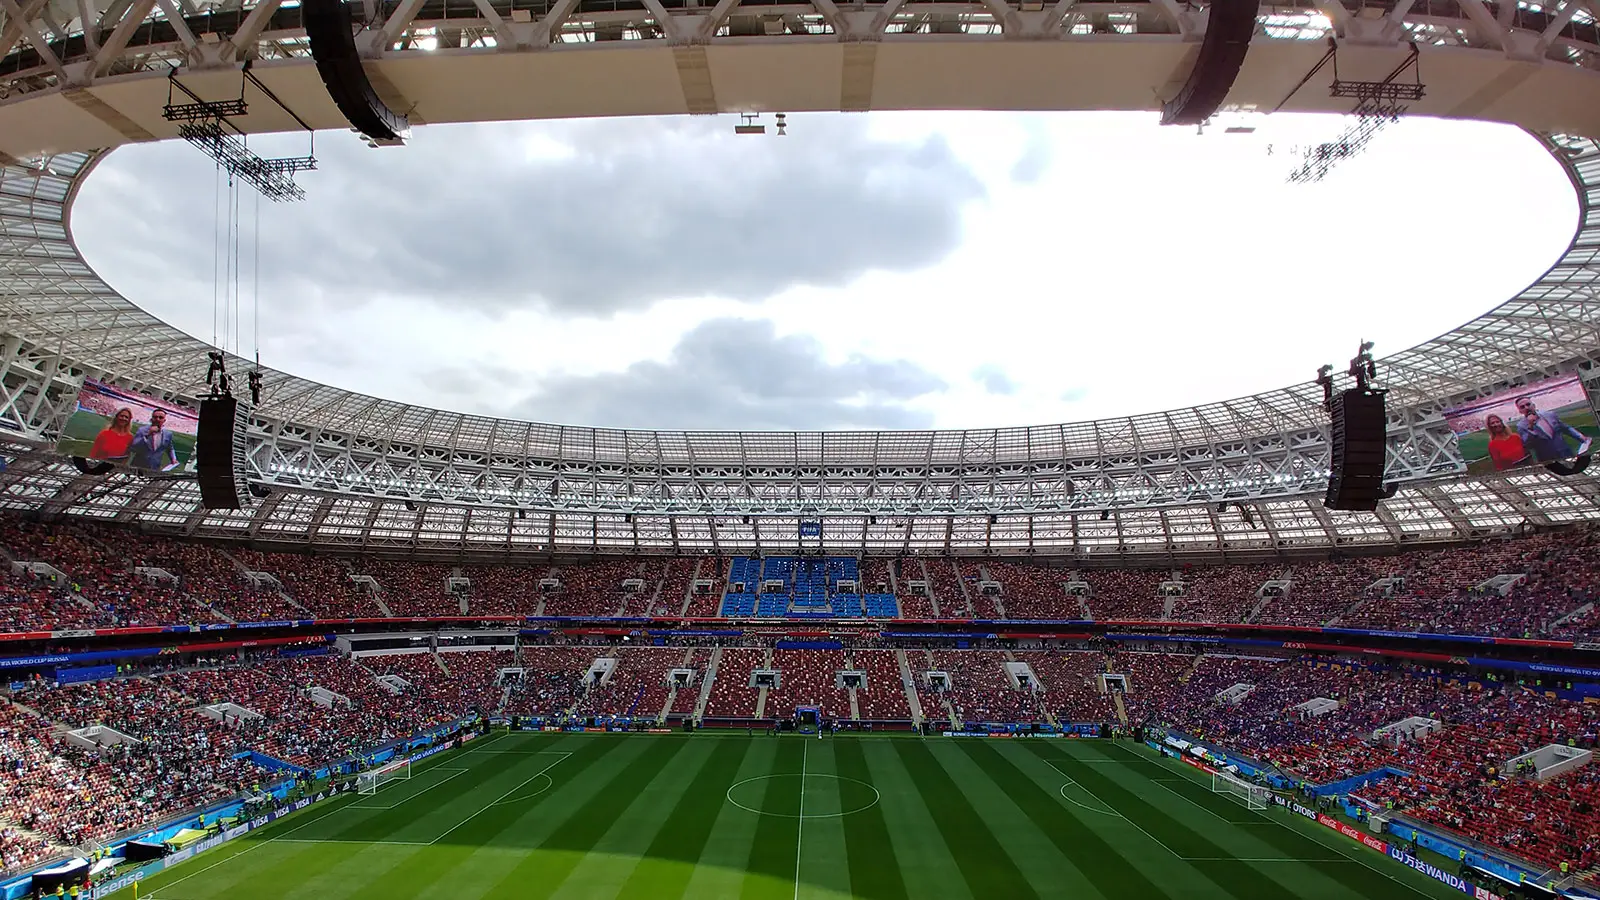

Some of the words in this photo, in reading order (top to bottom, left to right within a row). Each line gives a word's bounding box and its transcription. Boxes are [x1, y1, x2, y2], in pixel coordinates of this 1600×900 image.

[422, 749, 434, 757] vivo
[252, 815, 269, 829] VISA
[274, 806, 290, 819] VISA
[295, 798, 310, 810] VISA
[1275, 795, 1286, 806] KIA
[76, 871, 144, 900] Hisense
[1404, 854, 1426, 873] 万达
[1425, 863, 1467, 892] WANDA
